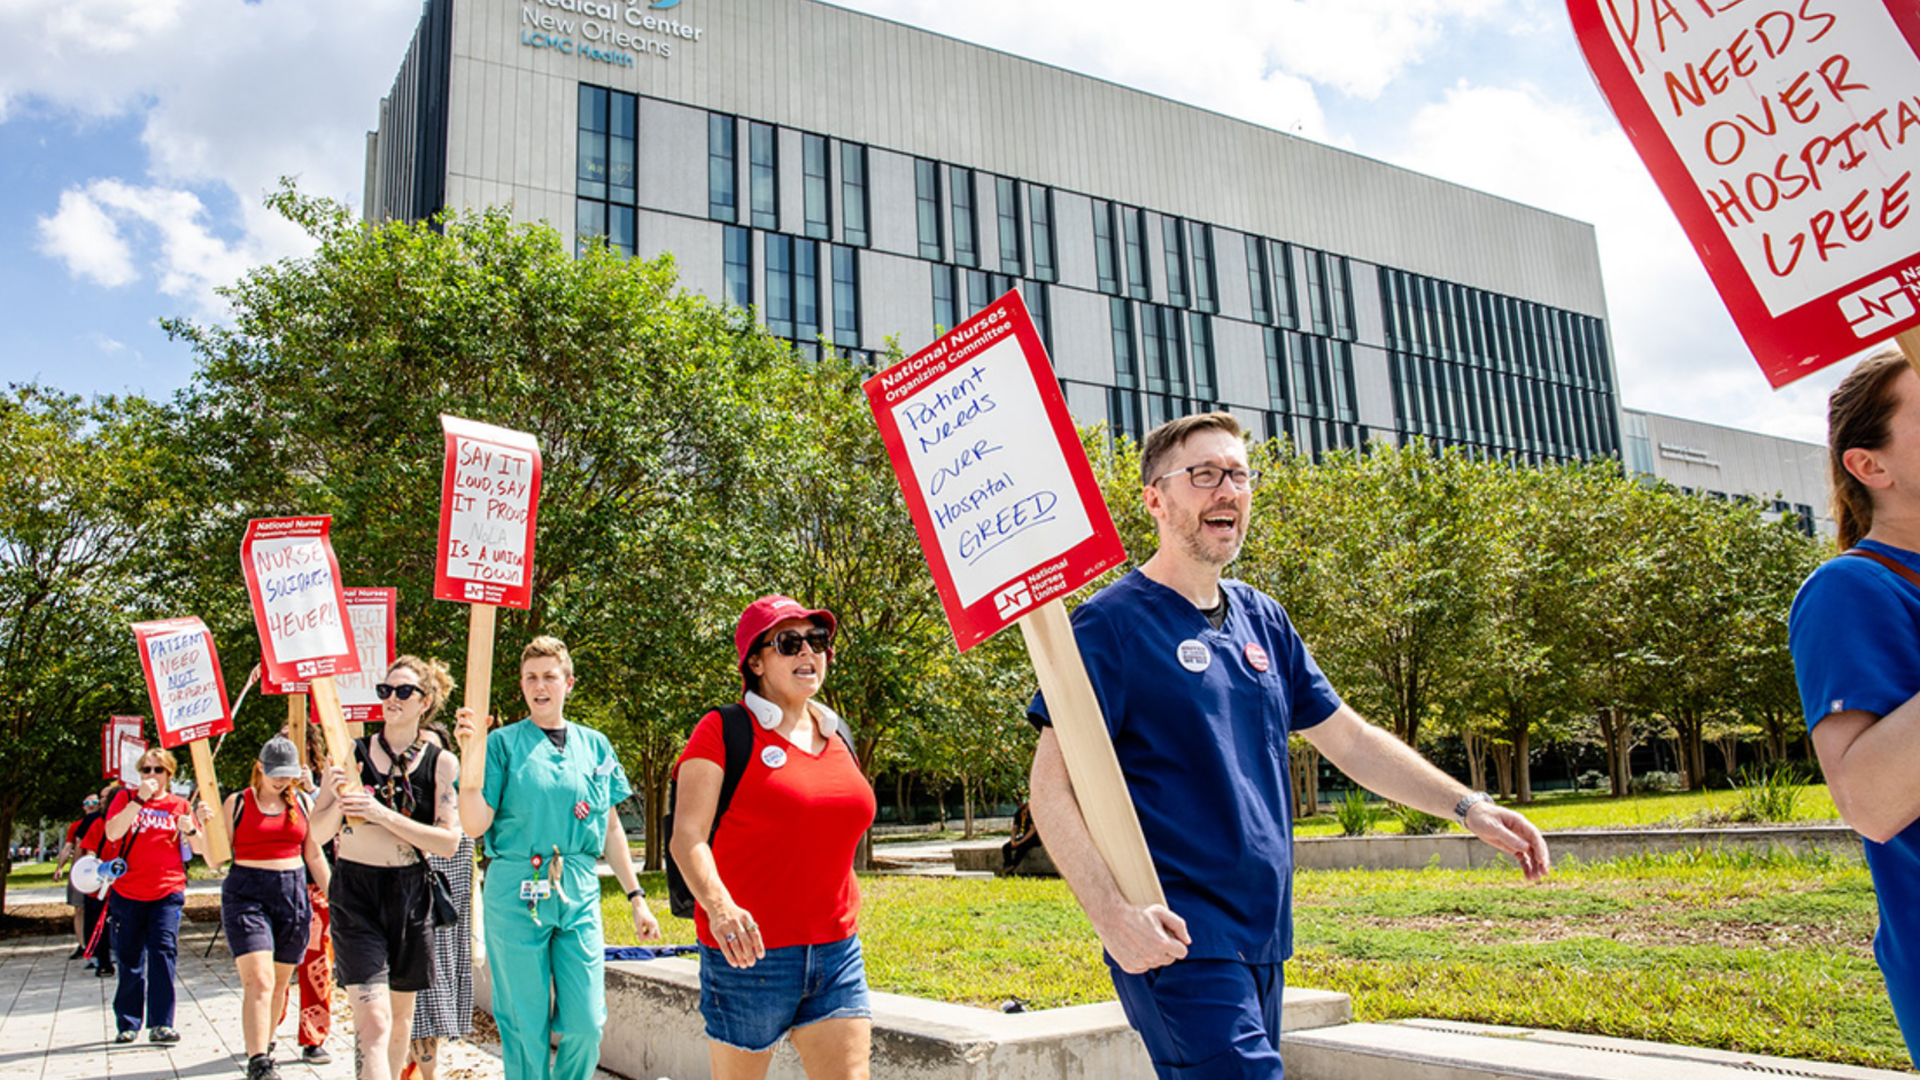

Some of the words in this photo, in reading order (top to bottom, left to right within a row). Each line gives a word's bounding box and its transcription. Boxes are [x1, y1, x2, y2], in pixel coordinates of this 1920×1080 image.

[522, 6, 575, 34] New
[582, 20, 672, 58] Orleans
[625, 8, 702, 41] Center
[522, 29, 573, 53] LCMC
[578, 42, 634, 67] Health
[1664, 0, 1836, 117] NEEDS
[1704, 54, 1870, 166] OVER
[1706, 96, 1920, 228] HOSPITA
[881, 341, 948, 391] National
[950, 306, 1007, 348] Nurses
[885, 360, 947, 402] Organizing
[947, 321, 1012, 364] Committee
[902, 366, 986, 431] Patient
[919, 393, 997, 454] Needs
[459, 441, 492, 472] SAY
[498, 454, 526, 476] IT
[456, 470, 494, 496] LOUD,
[497, 480, 526, 499] SAY
[934, 472, 1014, 530] Hospital
[257, 519, 294, 530] National
[453, 493, 476, 512] IT
[487, 498, 528, 525] PROUD
[958, 490, 1058, 559] GREED
[257, 542, 324, 575] NURSE
[478, 546, 487, 561] A
[1027, 557, 1069, 584] National
[1031, 572, 1065, 593] Nurses
[1034, 579, 1068, 602] United
[150, 630, 204, 660] PATIENT
[160, 649, 200, 677] NEED
